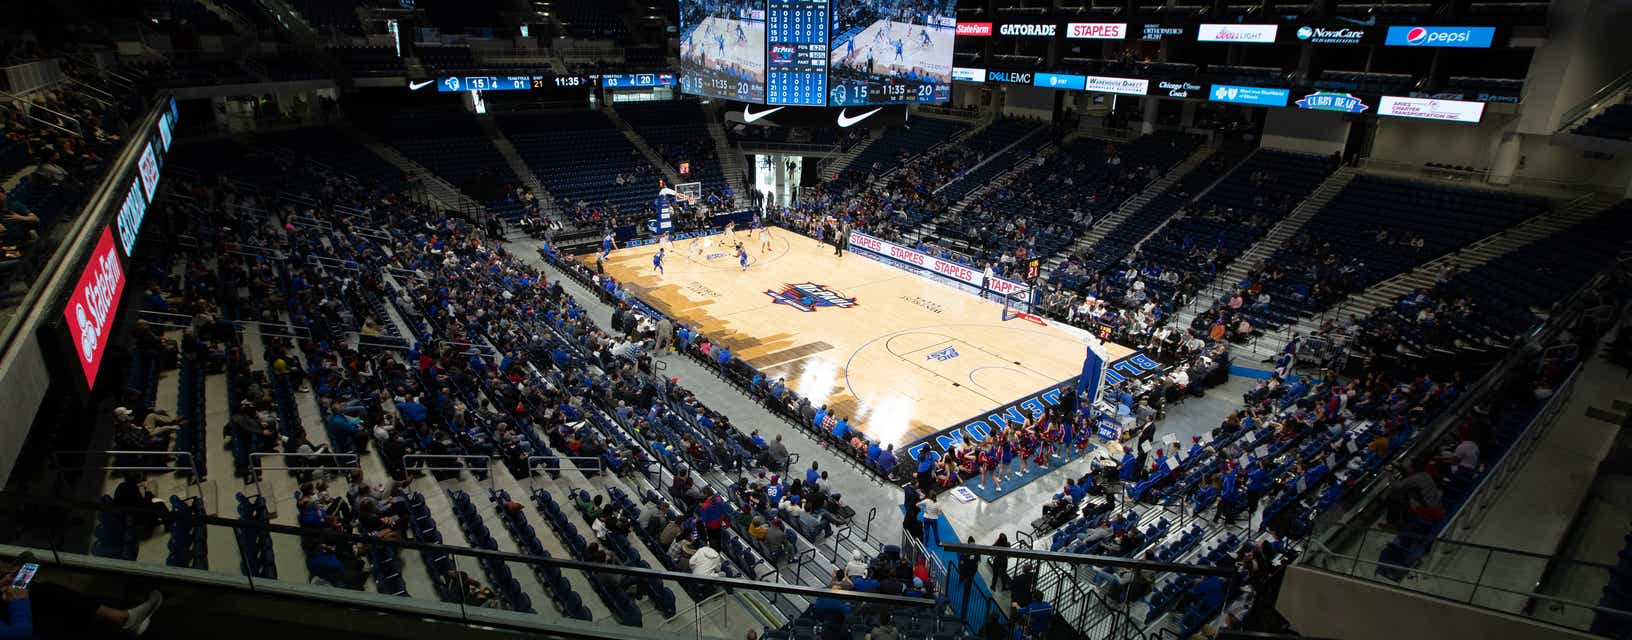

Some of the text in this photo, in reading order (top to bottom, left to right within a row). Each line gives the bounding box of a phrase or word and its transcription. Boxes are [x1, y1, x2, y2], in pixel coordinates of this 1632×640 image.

[1000, 24, 1056, 36] GATORADE
[1074, 25, 1119, 37] STAPLES
[1312, 28, 1364, 38] NovaCare
[1427, 30, 1471, 43] pepsi
[555, 77, 579, 86] 11:35
[694, 78, 703, 88] 15
[712, 79, 727, 89] 11:35
[1159, 81, 1182, 90] Chicago
[738, 82, 748, 94] 20
[854, 86, 868, 98] 15
[883, 85, 905, 95] 11:35
[918, 85, 932, 96] 20
[1308, 96, 1356, 109] CUBBY BEAR
[851, 234, 881, 251] STAPLES
[891, 247, 924, 265] STAPLES
[935, 260, 972, 281] STAPLES
[1028, 268, 1038, 277] 21
